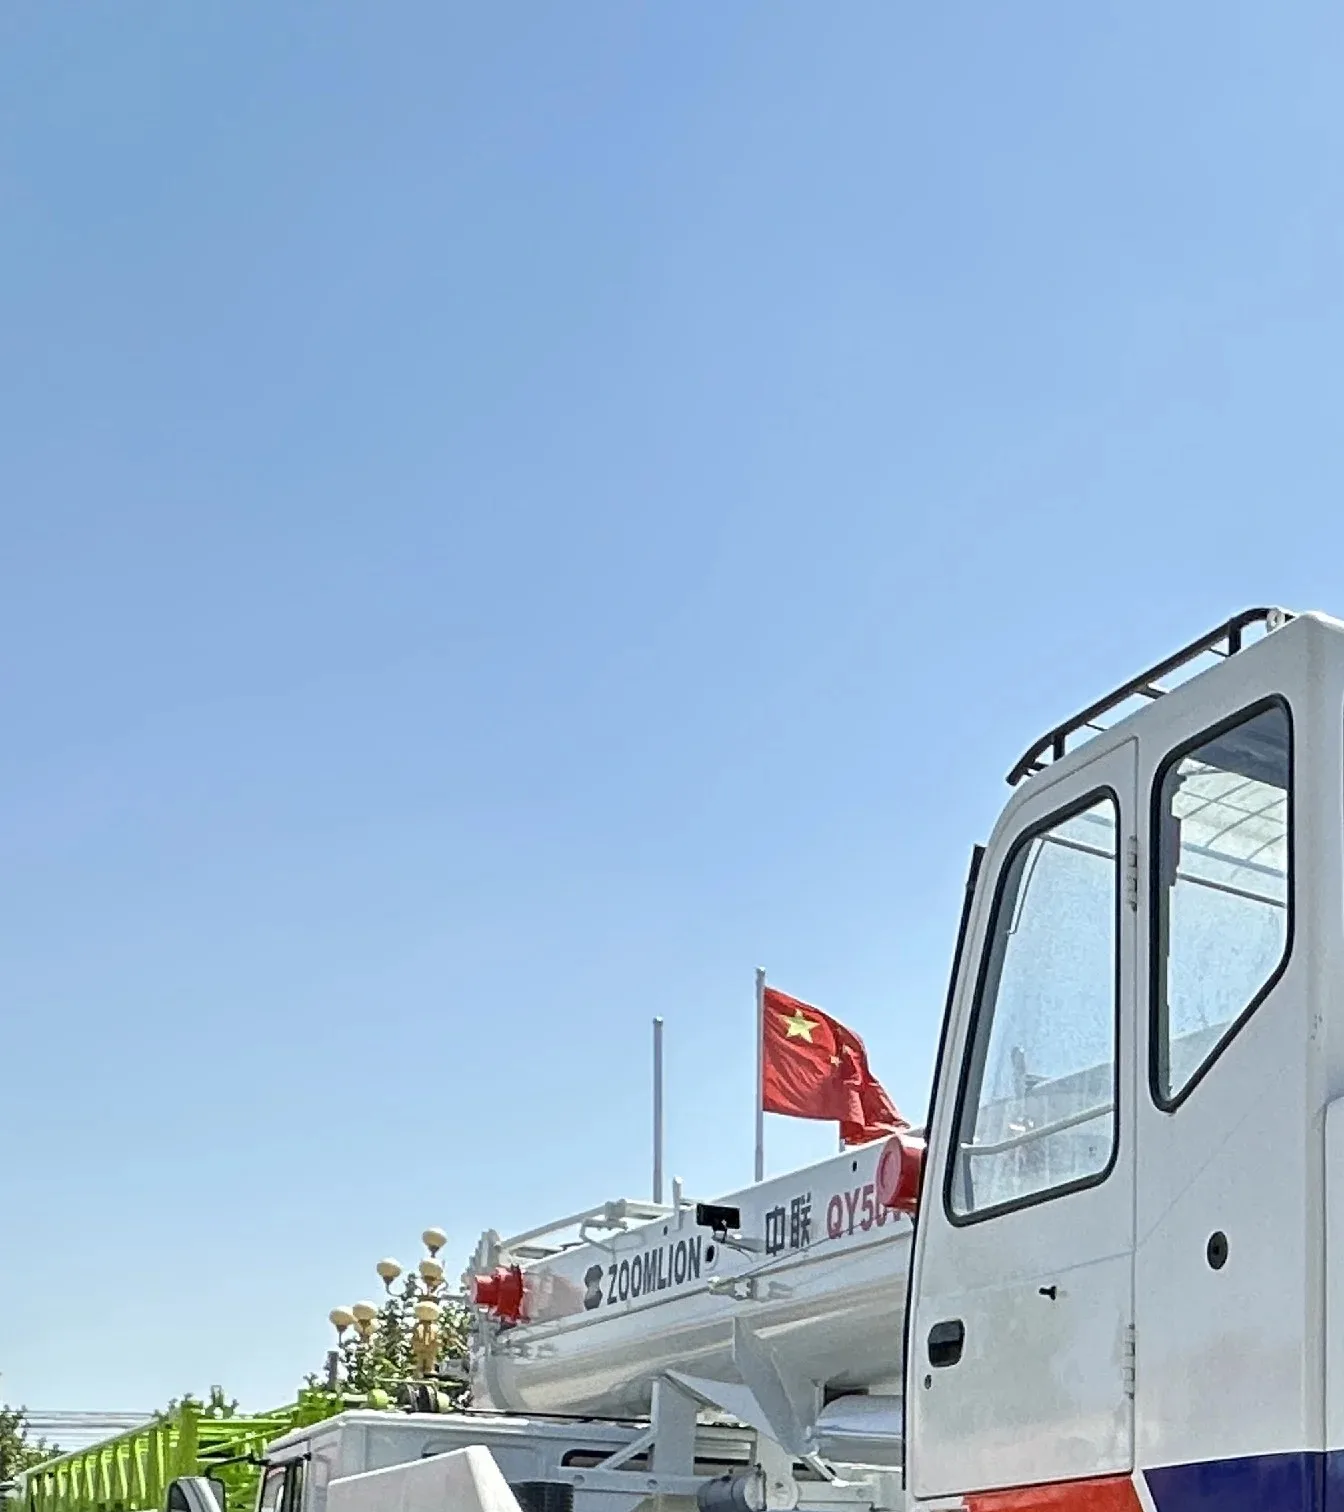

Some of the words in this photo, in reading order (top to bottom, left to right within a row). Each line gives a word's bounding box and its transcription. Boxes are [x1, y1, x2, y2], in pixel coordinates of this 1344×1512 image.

[606, 1235, 702, 1305] ZOOMLION
[765, 1193, 812, 1256] 中联
[826, 1184, 901, 1240] QY50
